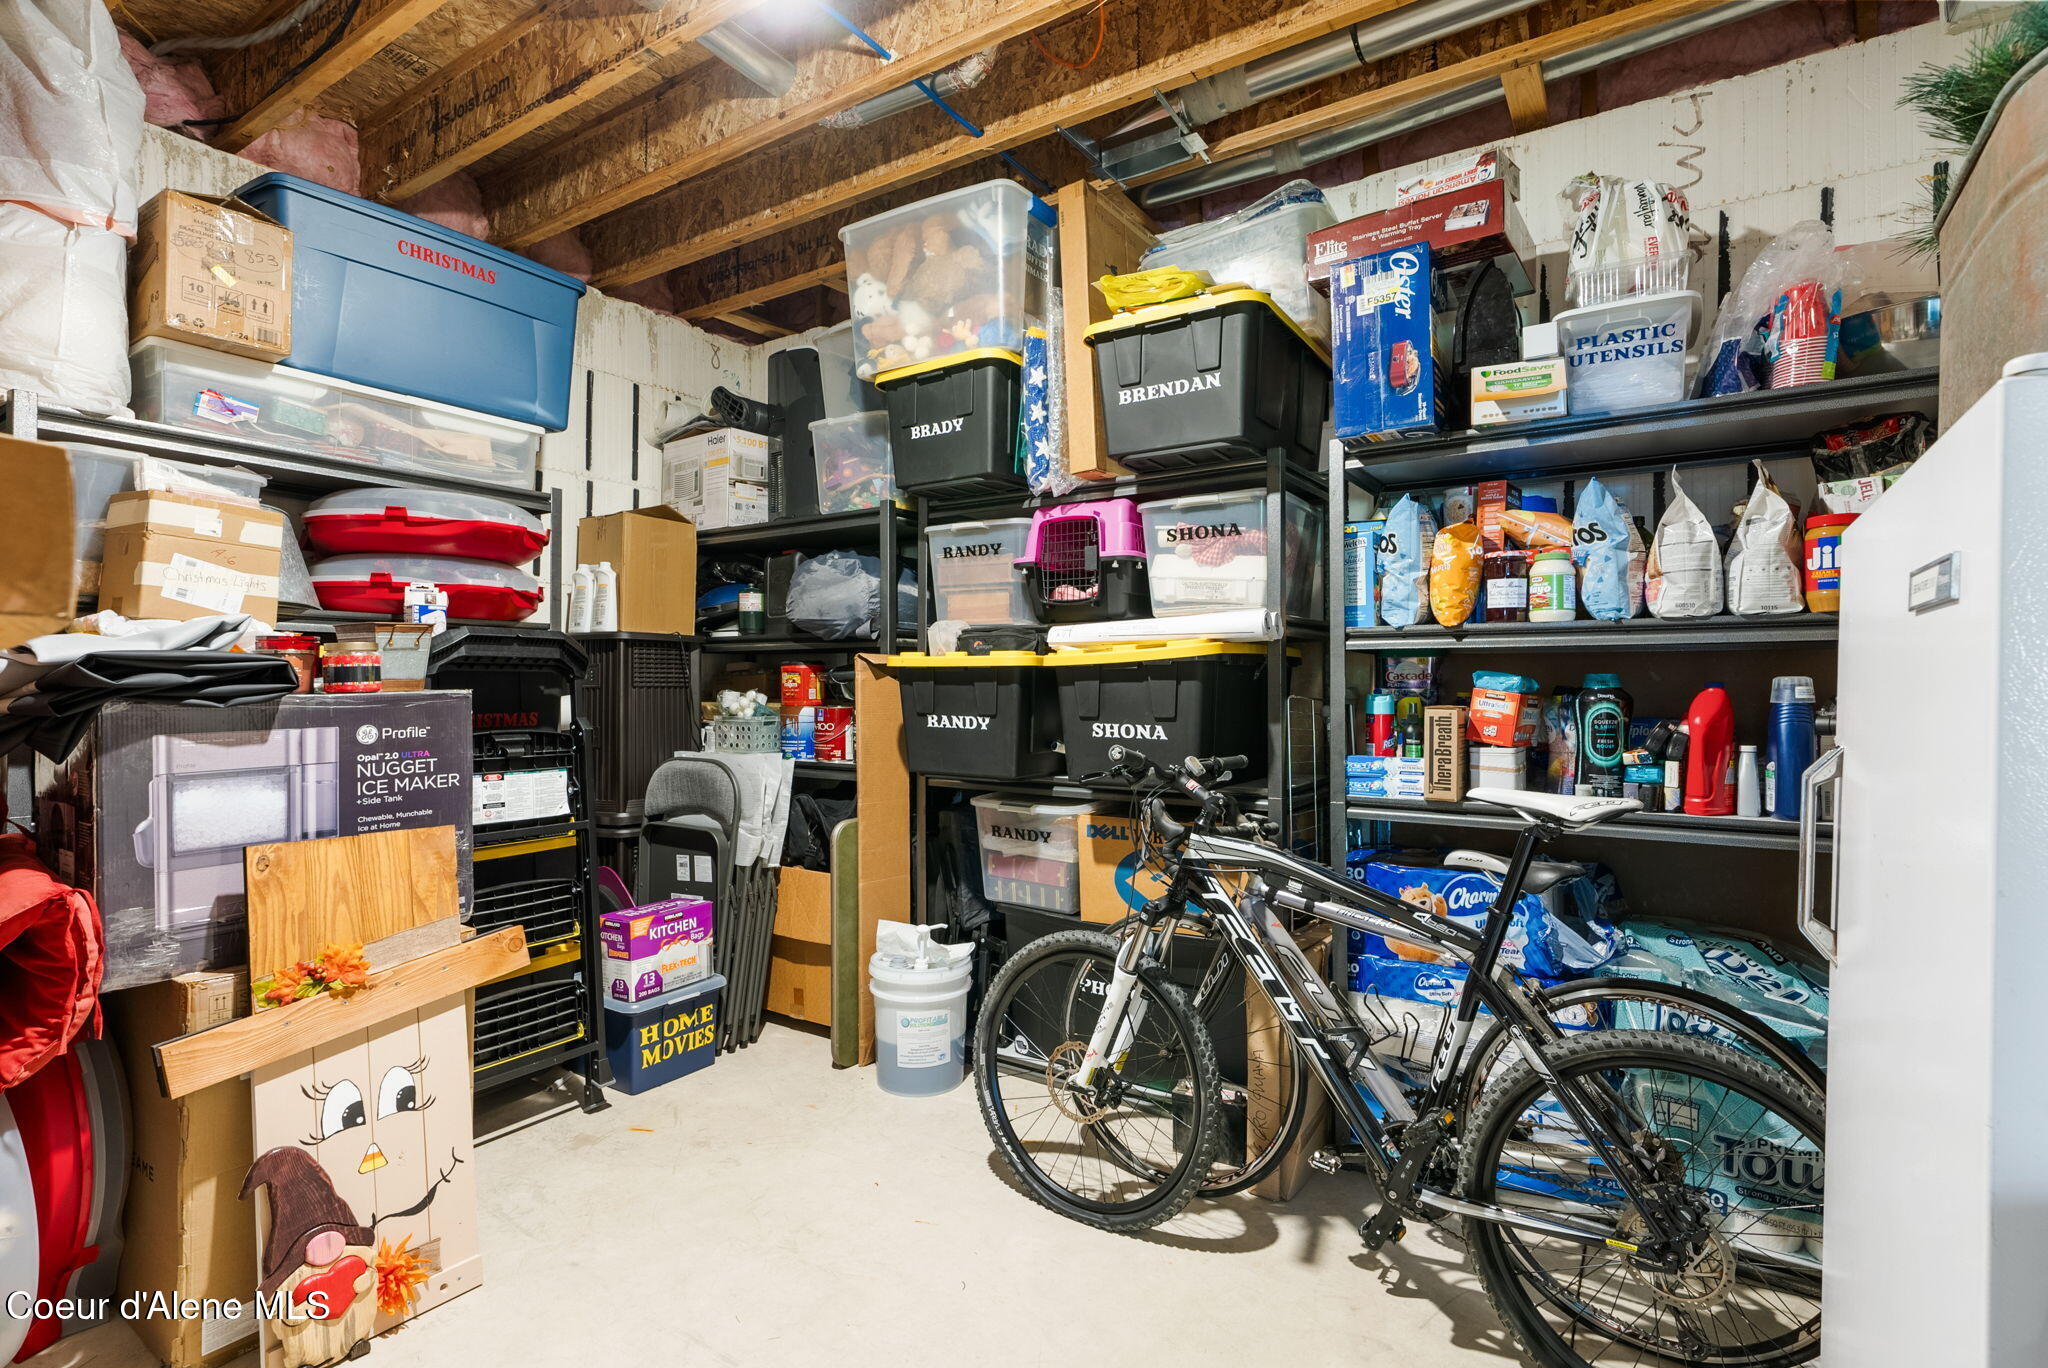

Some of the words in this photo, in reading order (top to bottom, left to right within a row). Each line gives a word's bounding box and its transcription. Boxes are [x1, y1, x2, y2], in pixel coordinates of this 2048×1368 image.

[1420, 212, 1443, 225] Server
[1378, 228, 1407, 241] Warming
[1408, 223, 1423, 234] Tray
[244, 248, 280, 268] 853
[1314, 240, 1348, 258] Elite
[397, 239, 497, 285] CHRISTMAS
[188, 282, 205, 294] 10
[1389, 252, 1420, 320] Oster
[1367, 292, 1397, 306] F5357
[1575, 323, 1677, 351] PLASTIC
[1568, 337, 1685, 369] UTENSILS
[1492, 362, 1557, 377] FoodSaver
[1118, 372, 1221, 406] BRENDAN
[911, 417, 964, 440] BRADY
[707, 433, 727, 446] Haier
[1857, 479, 1875, 502] JELL
[1166, 522, 1243, 543] SHONA
[943, 542, 1002, 559] RANDY
[163, 566, 229, 588] Christmas
[231, 575, 268, 593] Lights
[1386, 670, 1433, 682] Cascade
[472, 711, 541, 729] ISTMAS
[926, 714, 990, 731] RANDY
[1092, 722, 1168, 741] SHONA
[384, 751, 399, 760] 2.0
[401, 750, 430, 759] ULTRA
[357, 758, 438, 778] NUGGET
[357, 779, 389, 796] ICE
[394, 773, 460, 793] MAKER
[384, 794, 403, 803] Tank
[357, 812, 395, 823] Chewable,
[396, 807, 433, 819] Munchable
[358, 824, 369, 832] Ice
[370, 823, 378, 831] at
[379, 820, 401, 829] Home
[991, 824, 1053, 844] RANDY
[1086, 823, 1129, 840] DELL
[1449, 886, 1500, 910] Charm
[649, 917, 697, 940] KITCHEN
[690, 931, 705, 941] Bags
[615, 980, 624, 989] 13
[642, 972, 656, 986] 13
[638, 989, 648, 998] 200
[648, 986, 661, 995] BAGS
[640, 1003, 713, 1047] HOME
[641, 1024, 715, 1069] MOVIES
[1757, 1138, 1824, 1162] PREMI
